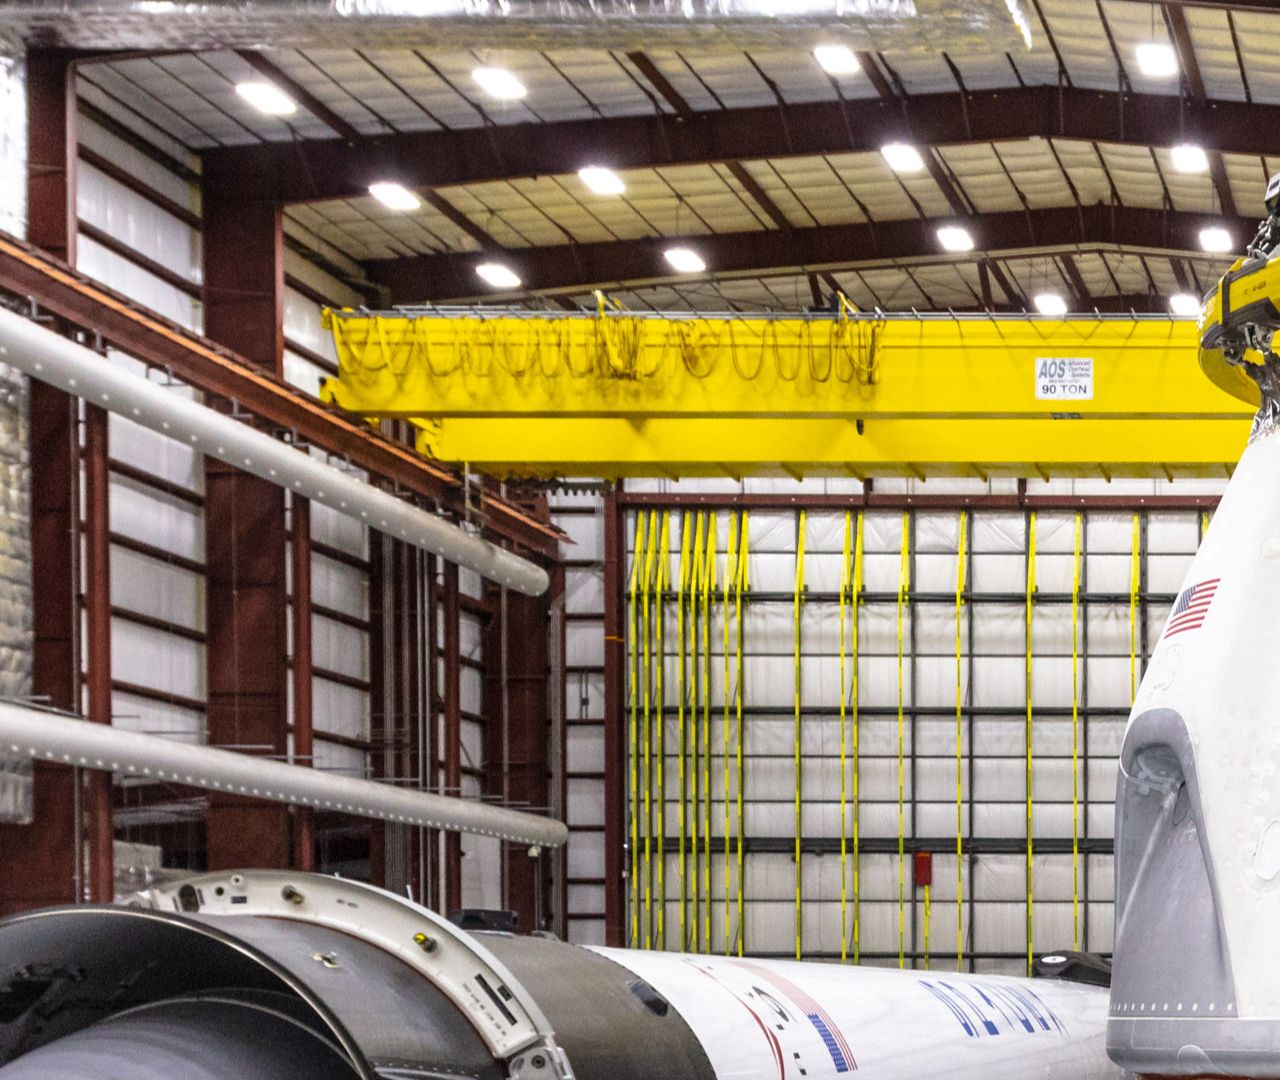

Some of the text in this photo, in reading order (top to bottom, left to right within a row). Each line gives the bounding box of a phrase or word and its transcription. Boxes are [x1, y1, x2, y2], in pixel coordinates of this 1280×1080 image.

[1038, 359, 1066, 379] AOS
[1042, 384, 1087, 394] 90 TON
